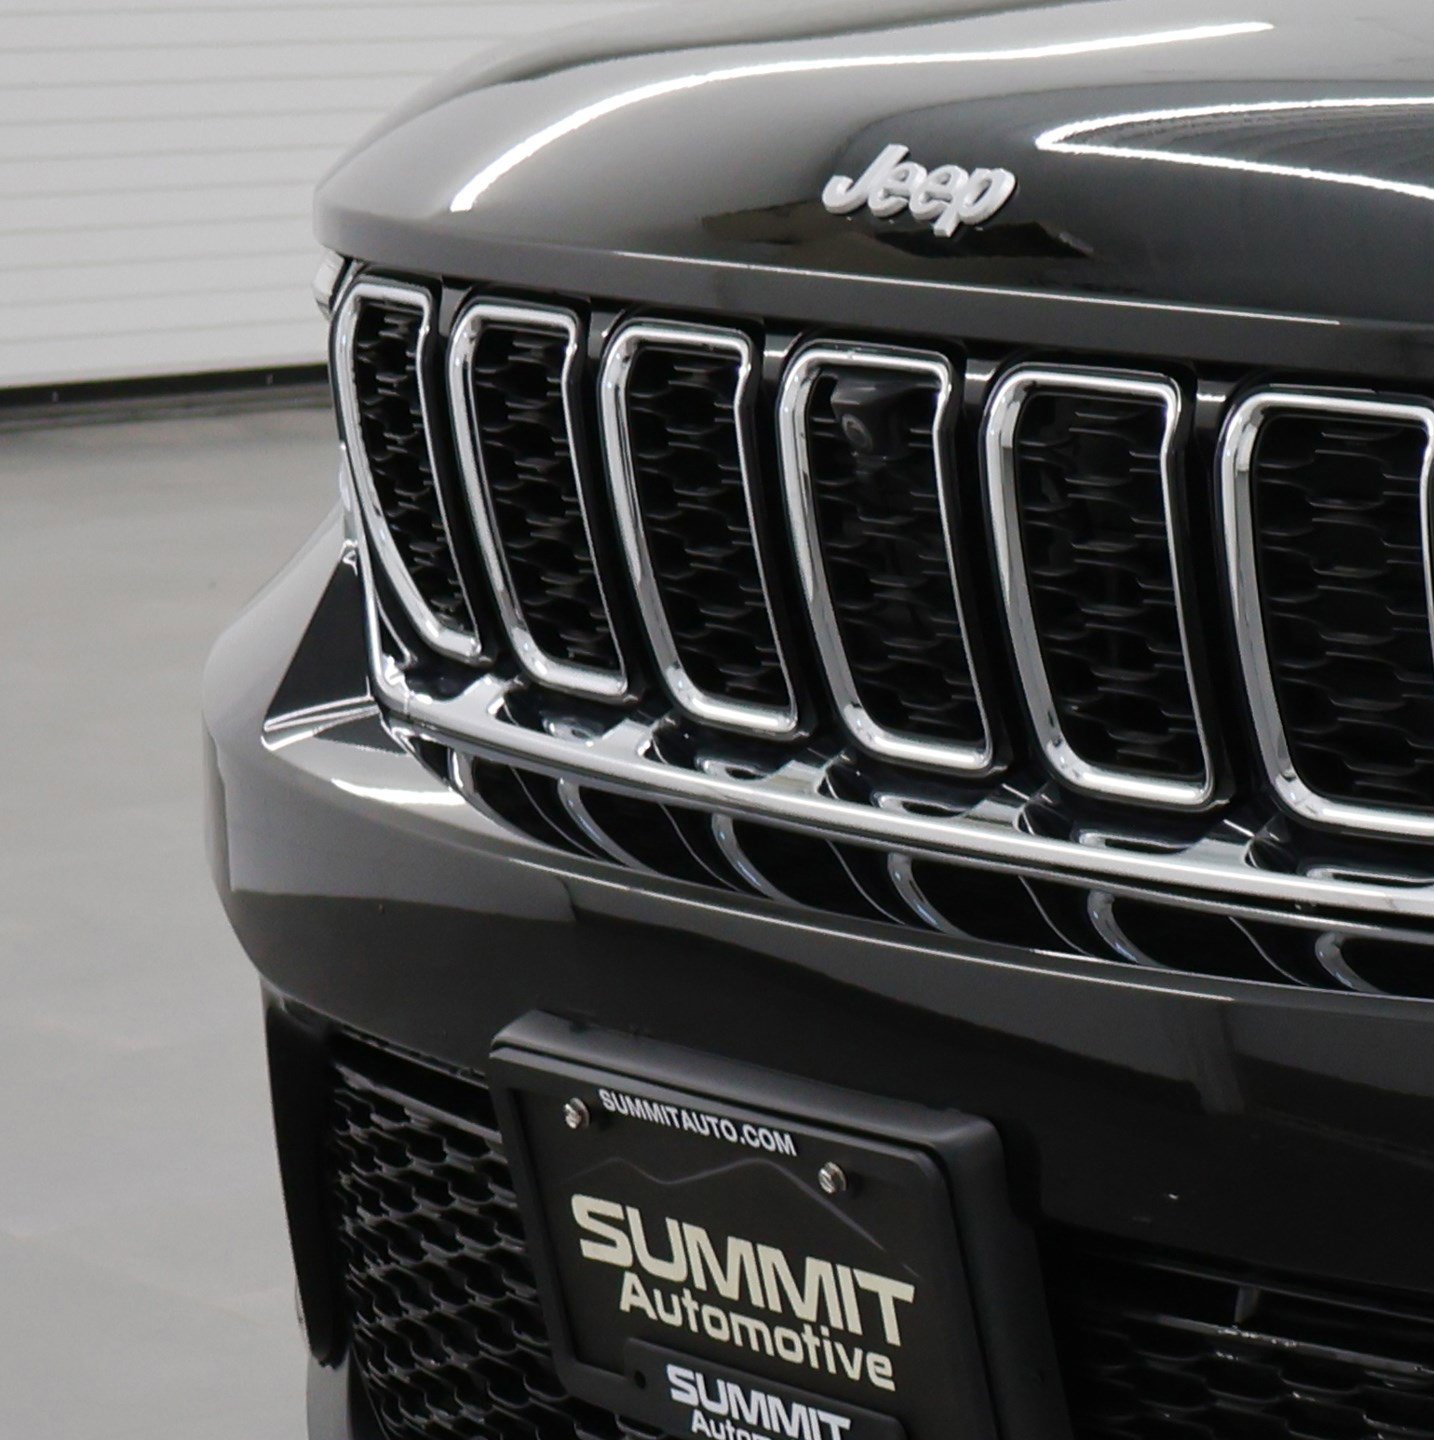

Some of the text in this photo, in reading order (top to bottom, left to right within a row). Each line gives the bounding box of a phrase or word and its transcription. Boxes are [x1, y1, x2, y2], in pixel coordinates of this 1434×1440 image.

[822, 143, 1018, 238] Jeep
[598, 1088, 798, 1157] SUMMITAUTO.COM
[570, 1192, 916, 1347] SUMMIT
[618, 1271, 897, 1392] Automotive
